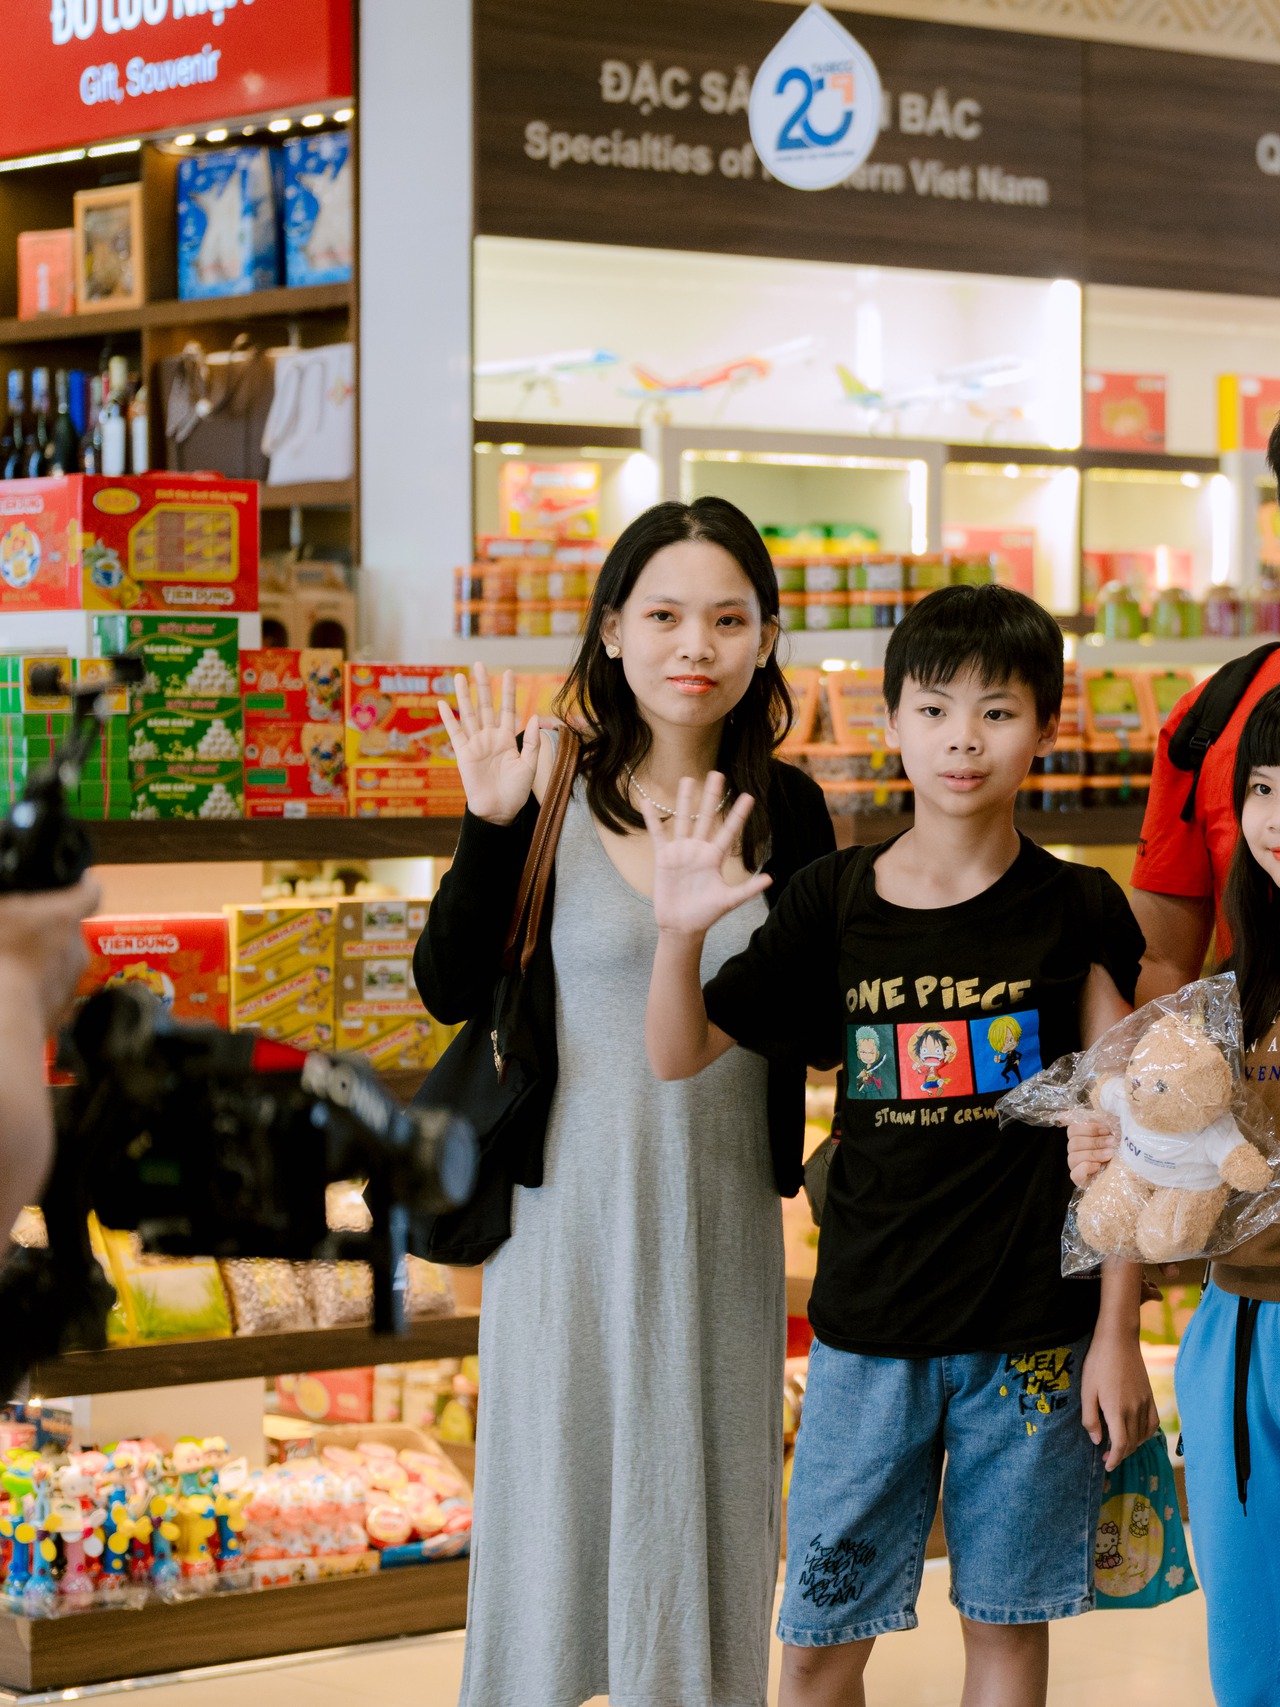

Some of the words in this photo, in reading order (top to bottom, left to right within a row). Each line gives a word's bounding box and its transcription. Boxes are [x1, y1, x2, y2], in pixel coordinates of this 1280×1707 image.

[126, 43, 221, 97] Souvenir
[699, 64, 753, 115] SẢ
[524, 119, 713, 178] Specialties
[908, 158, 973, 201] Viet
[974, 165, 1051, 208] Nam
[845, 976, 905, 1014] ONE
[1267, 1037, 1278, 1052] A
